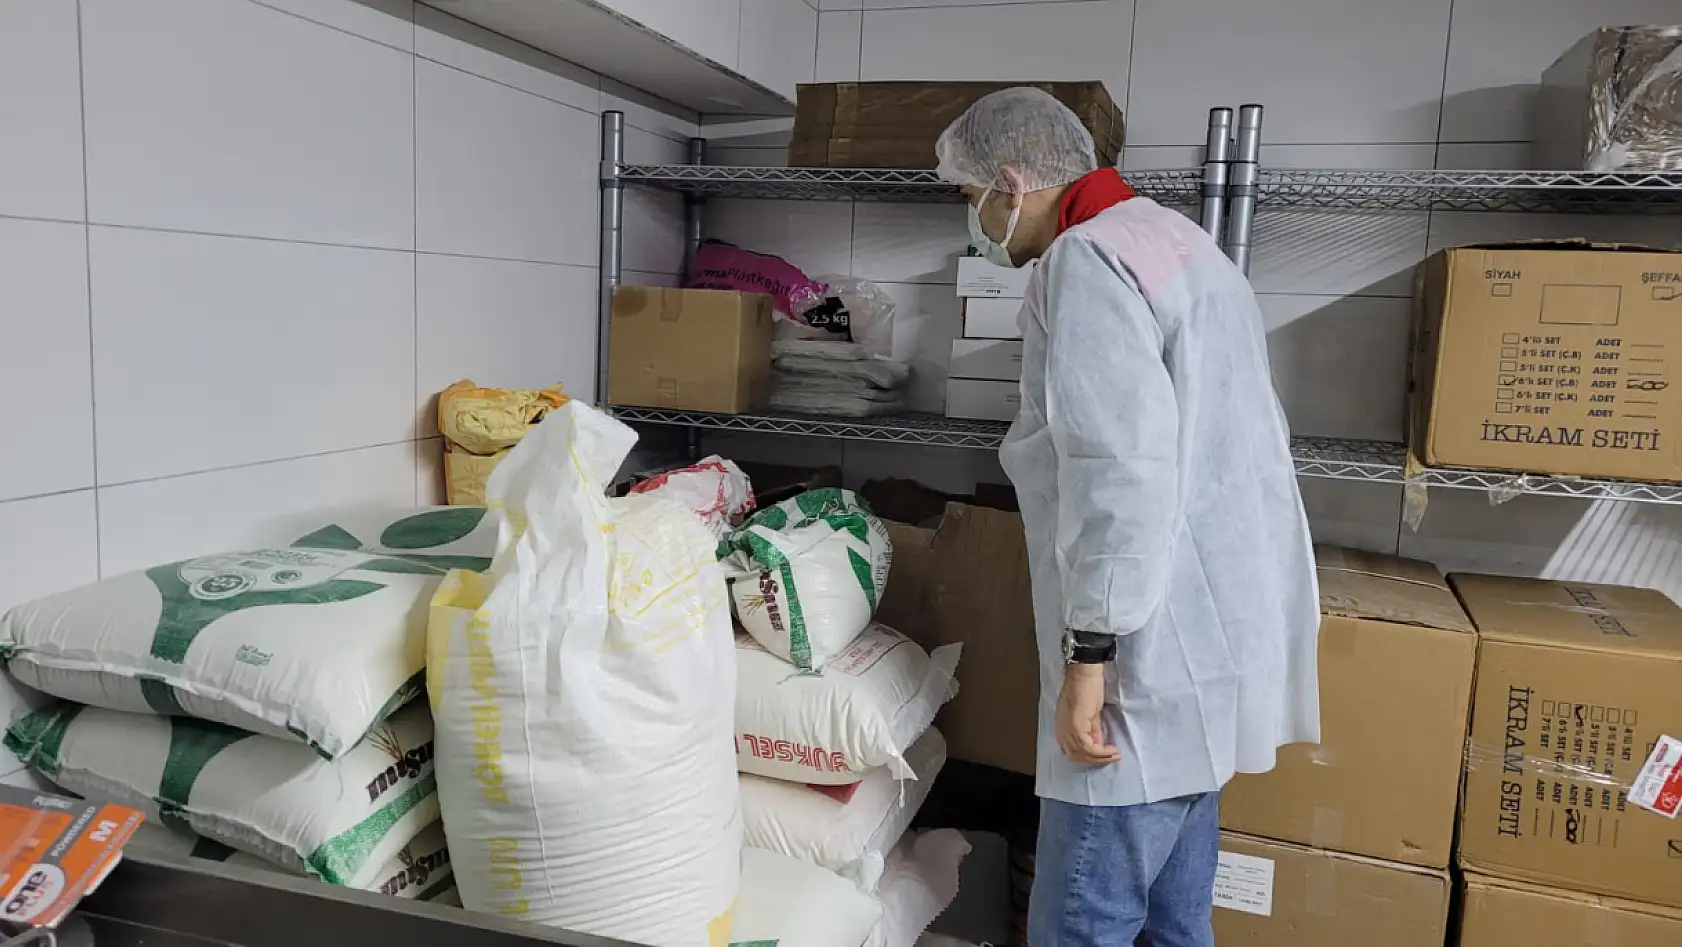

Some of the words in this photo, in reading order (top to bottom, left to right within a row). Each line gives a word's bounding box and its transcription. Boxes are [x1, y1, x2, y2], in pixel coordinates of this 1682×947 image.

[811, 313, 830, 324] 2.5
[833, 311, 848, 326] kg
[1545, 336, 1561, 345] SET
[1596, 338, 1622, 347] ADET
[1540, 349, 1557, 357] SET
[1594, 352, 1620, 360] ADET
[1538, 364, 1555, 373] SET
[1592, 366, 1619, 375] ADET
[1537, 377, 1553, 386] SET
[1591, 380, 1617, 388] ADET
[1536, 391, 1552, 400] SET
[1589, 394, 1615, 403] ADET
[1533, 406, 1551, 415] SET
[1587, 409, 1613, 418] ADET
[1480, 419, 1585, 447] İKRAM
[1591, 428, 1661, 451] SETİ
[1503, 685, 1535, 776] İKRAM
[1540, 732, 1549, 748] SET
[1557, 735, 1567, 749] SET
[1574, 738, 1584, 752] SET
[1589, 740, 1599, 755] SET
[1605, 741, 1616, 756] SET
[1621, 746, 1632, 761] SET
[1536, 778, 1545, 802] ADET
[1552, 781, 1562, 804] ADET
[1568, 784, 1578, 806] ADET
[1584, 786, 1593, 808] ADET
[1601, 788, 1611, 811] ADET
[1616, 790, 1626, 812] ADET
[1497, 780, 1523, 839] SETİ
[89, 820, 118, 842] M
[5, 870, 48, 914] one
